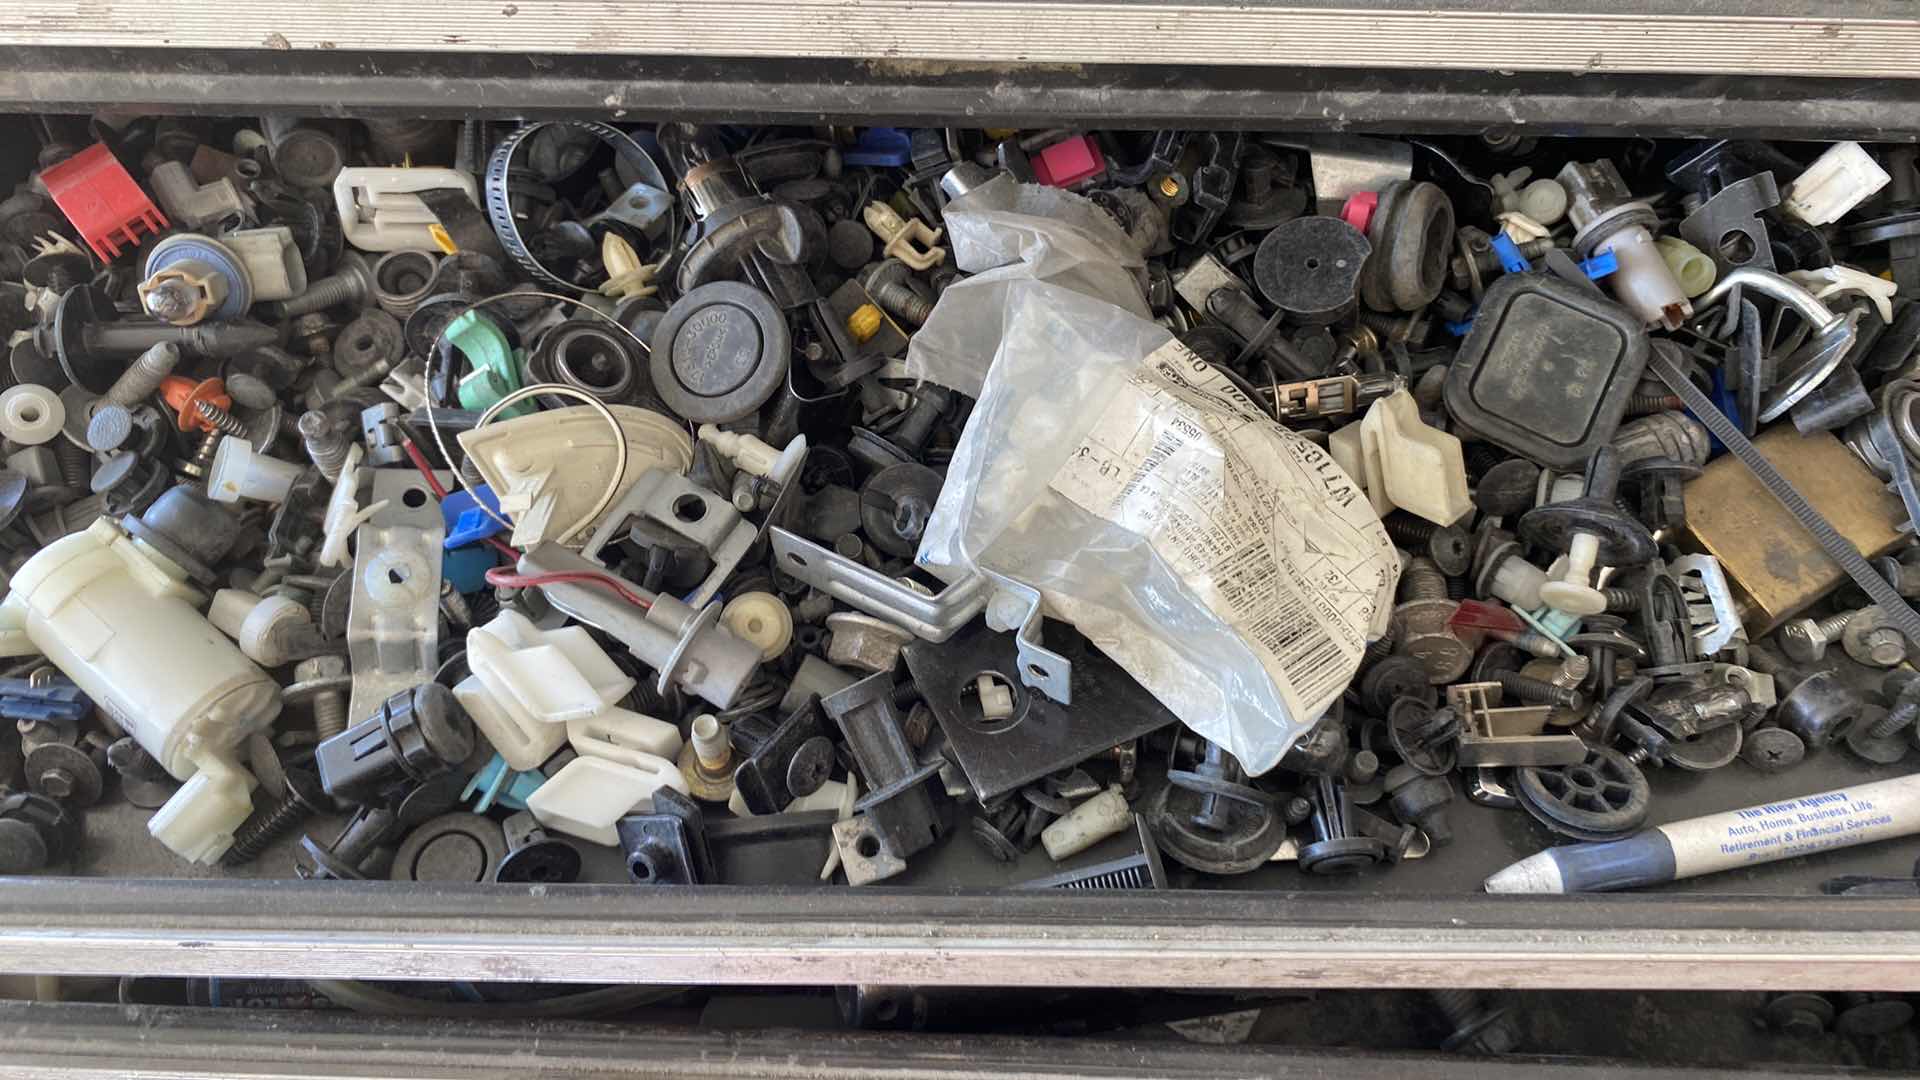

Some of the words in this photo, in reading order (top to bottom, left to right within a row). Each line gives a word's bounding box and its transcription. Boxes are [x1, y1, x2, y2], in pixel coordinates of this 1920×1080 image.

[1799, 792, 1848, 809] Agency
[1720, 836, 1782, 854] Retirement
[1784, 831, 1793, 842] &
[1795, 823, 1844, 839] Financial
[1847, 815, 1892, 829] Services
[1728, 823, 1759, 837] Auto,
